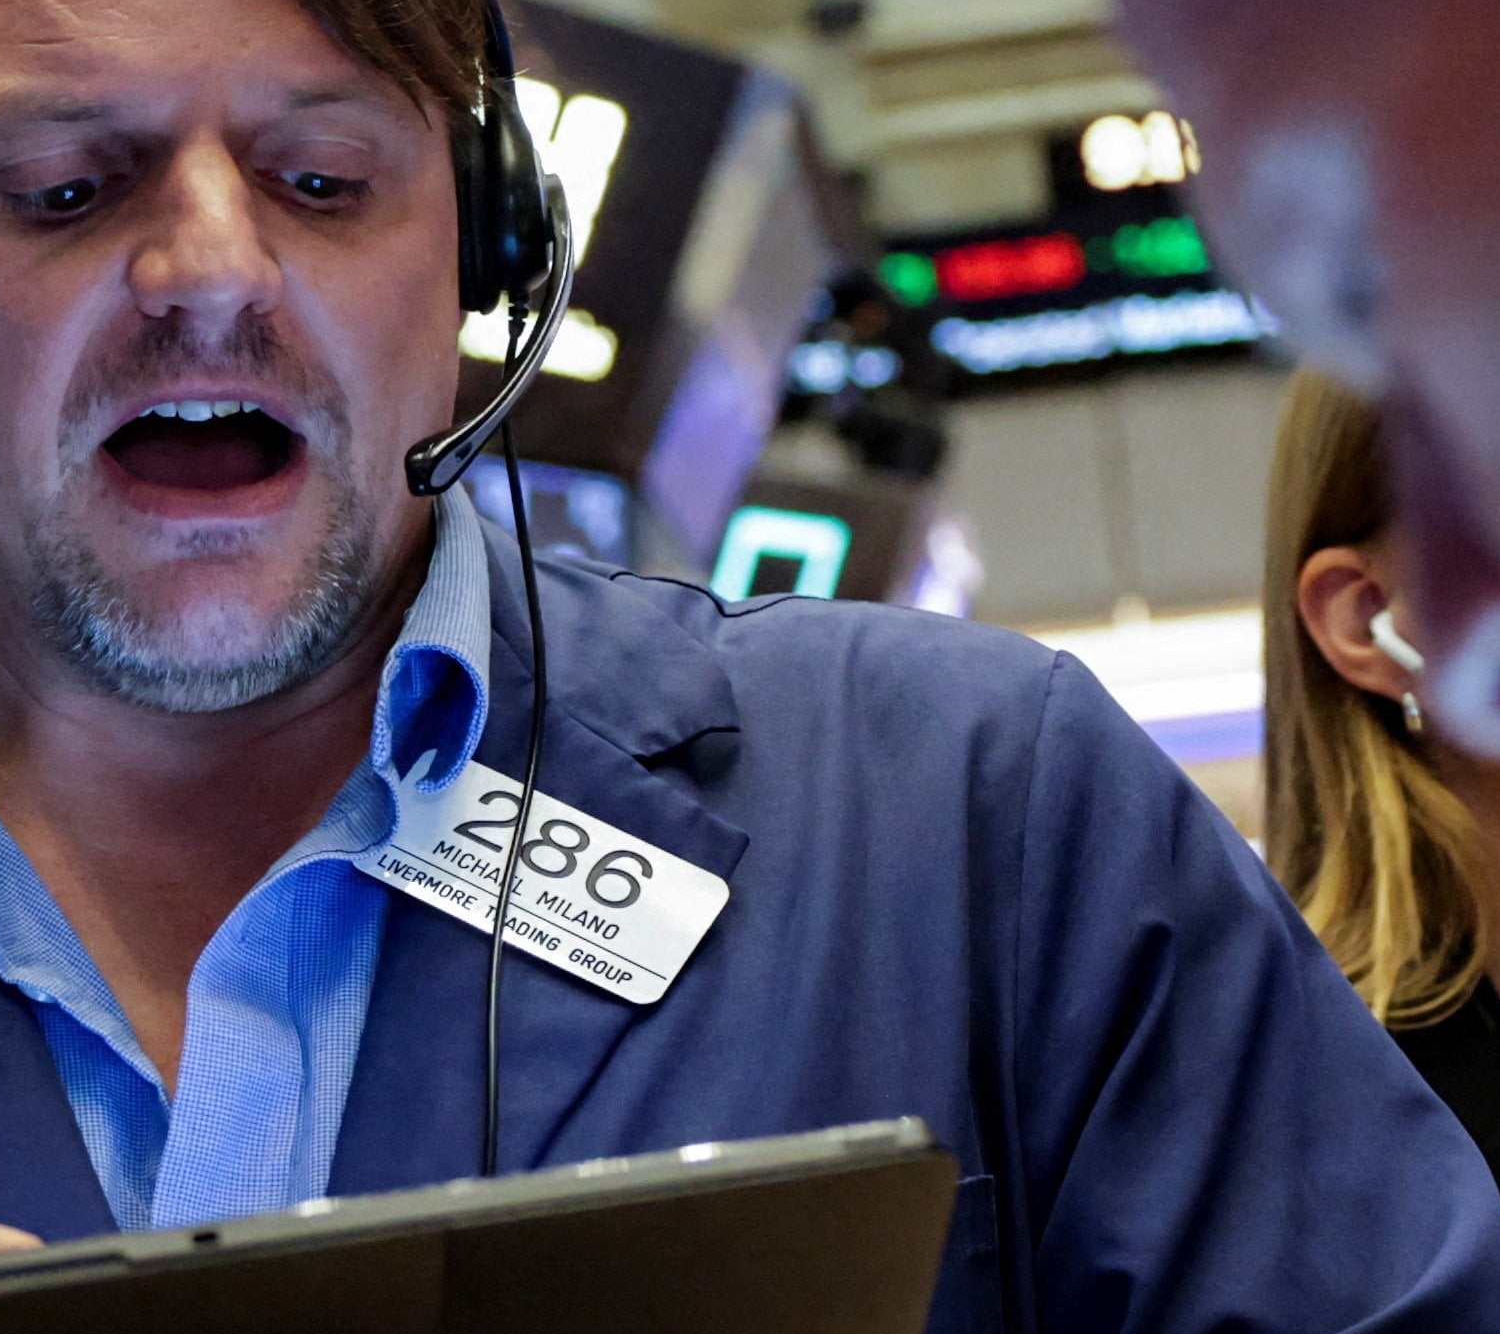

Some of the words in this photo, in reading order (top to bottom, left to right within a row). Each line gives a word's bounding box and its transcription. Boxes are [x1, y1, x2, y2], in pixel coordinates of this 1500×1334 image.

[453, 789, 654, 910] 286
[376, 854, 479, 911] LIVERMORE
[484, 904, 561, 953] TADING
[568, 948, 633, 986] GROUP
[536, 890, 621, 942] MILANO
